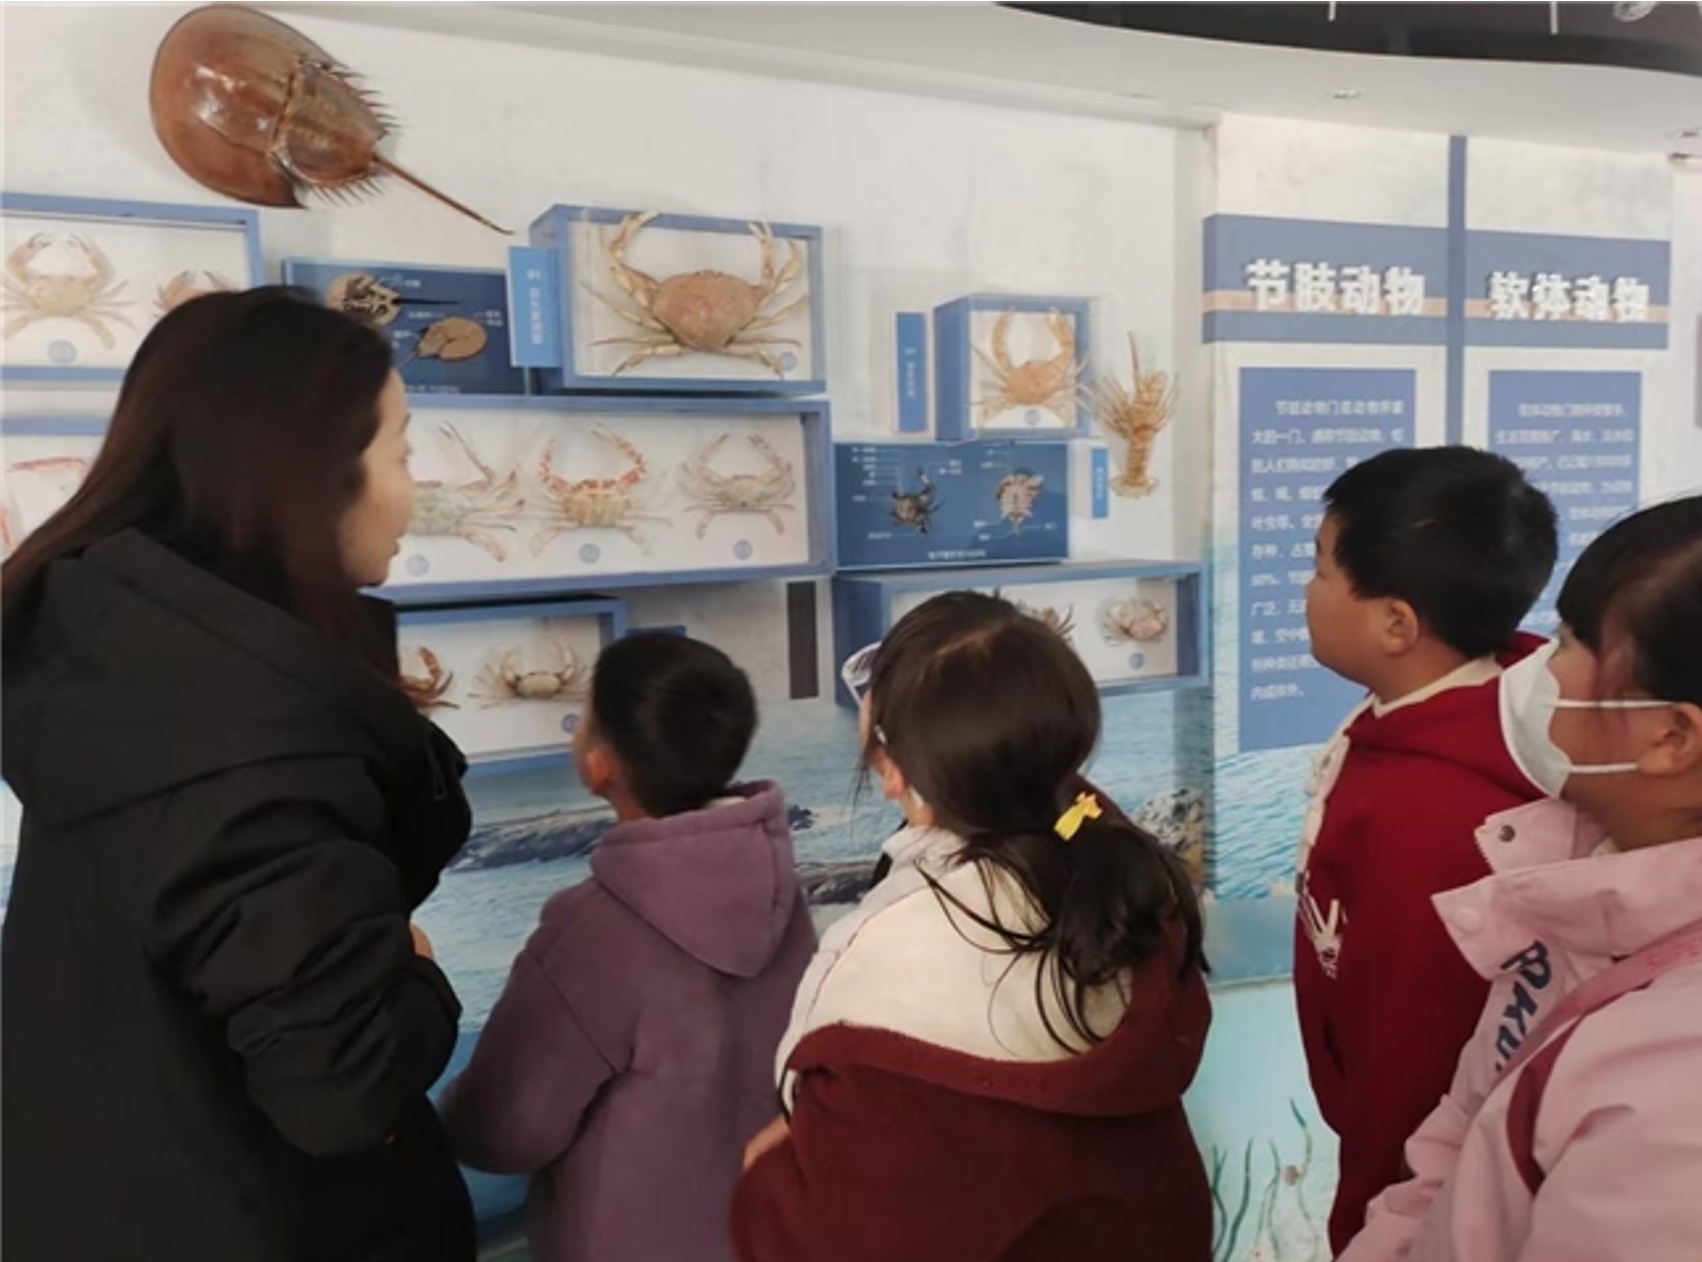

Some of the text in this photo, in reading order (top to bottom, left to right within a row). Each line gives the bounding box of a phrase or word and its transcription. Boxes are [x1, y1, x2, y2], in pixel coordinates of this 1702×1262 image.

[1246, 259, 1426, 315] 节肢动物
[1489, 271, 1651, 323] 软体动物
